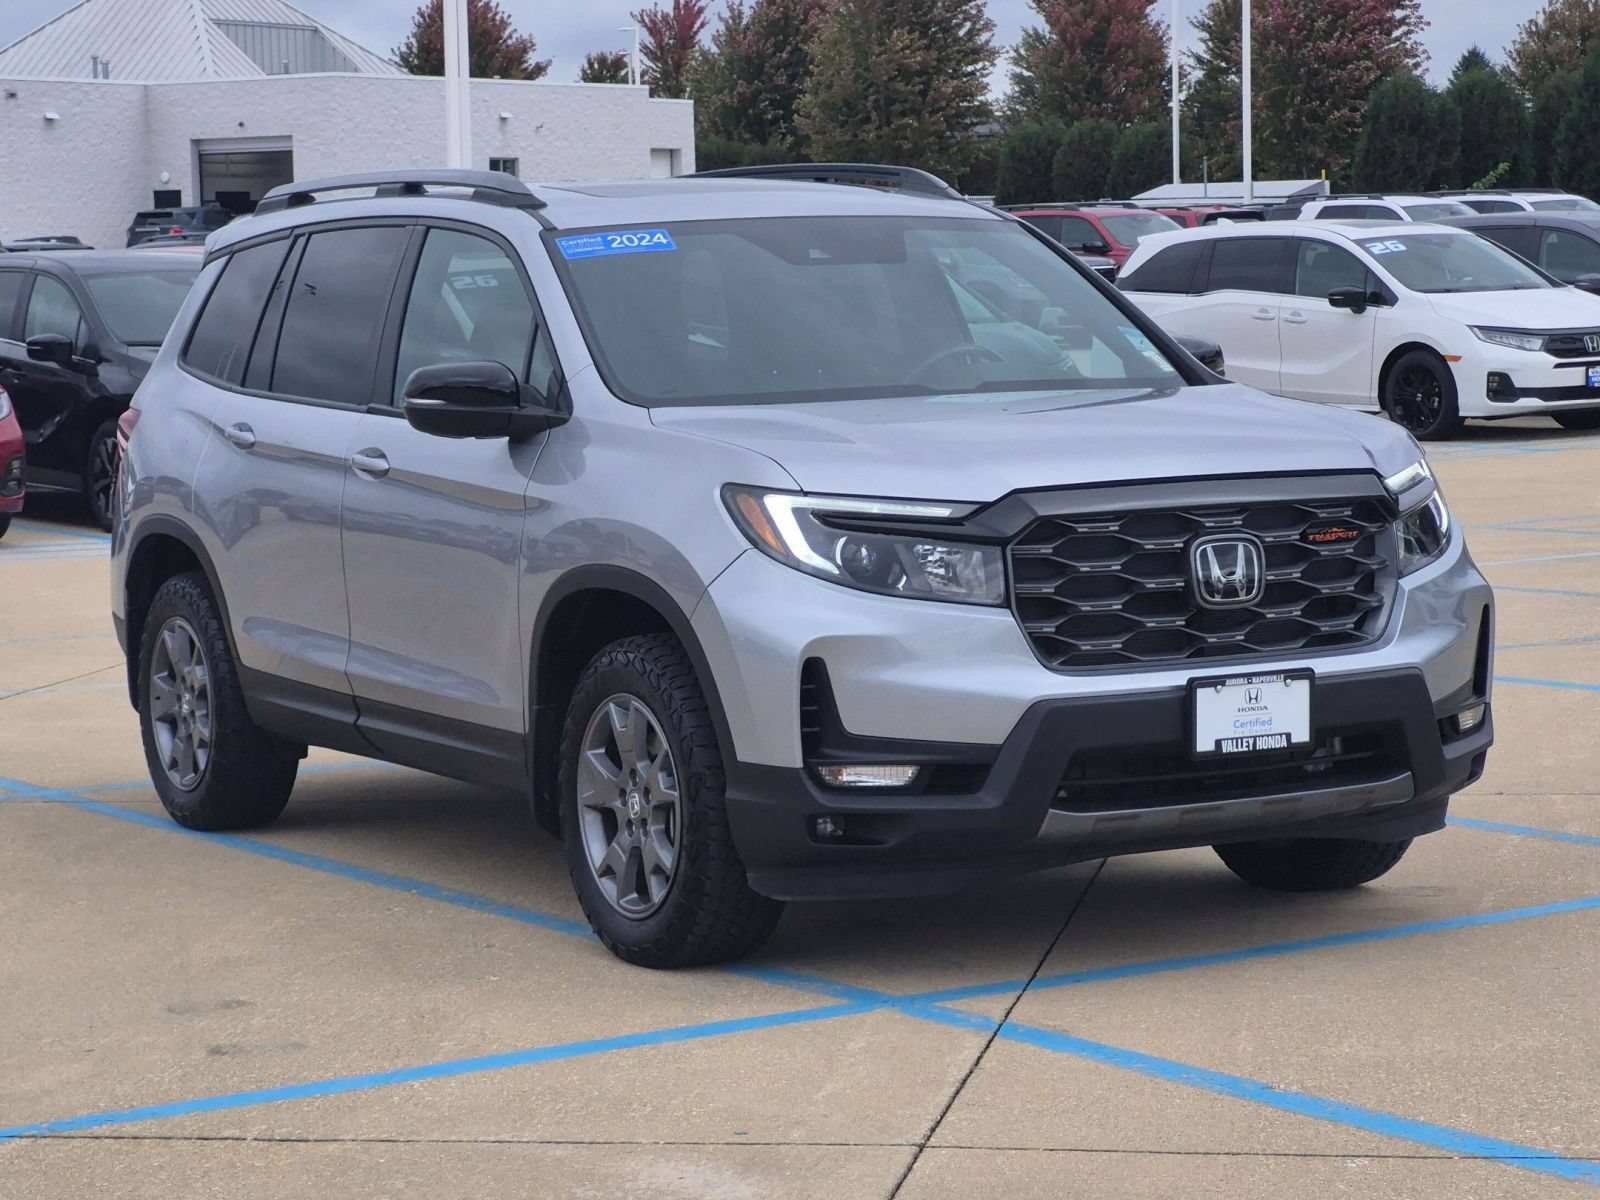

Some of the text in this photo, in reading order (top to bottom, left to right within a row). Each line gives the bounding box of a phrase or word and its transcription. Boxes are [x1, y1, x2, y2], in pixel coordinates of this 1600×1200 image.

[607, 233, 669, 248] 2024
[1365, 240, 1407, 255] 26
[450, 274, 499, 290] 26
[1237, 705, 1269, 713] HONDA
[1233, 716, 1273, 729] Certified
[1221, 734, 1288, 753] VALLEY HONDA
